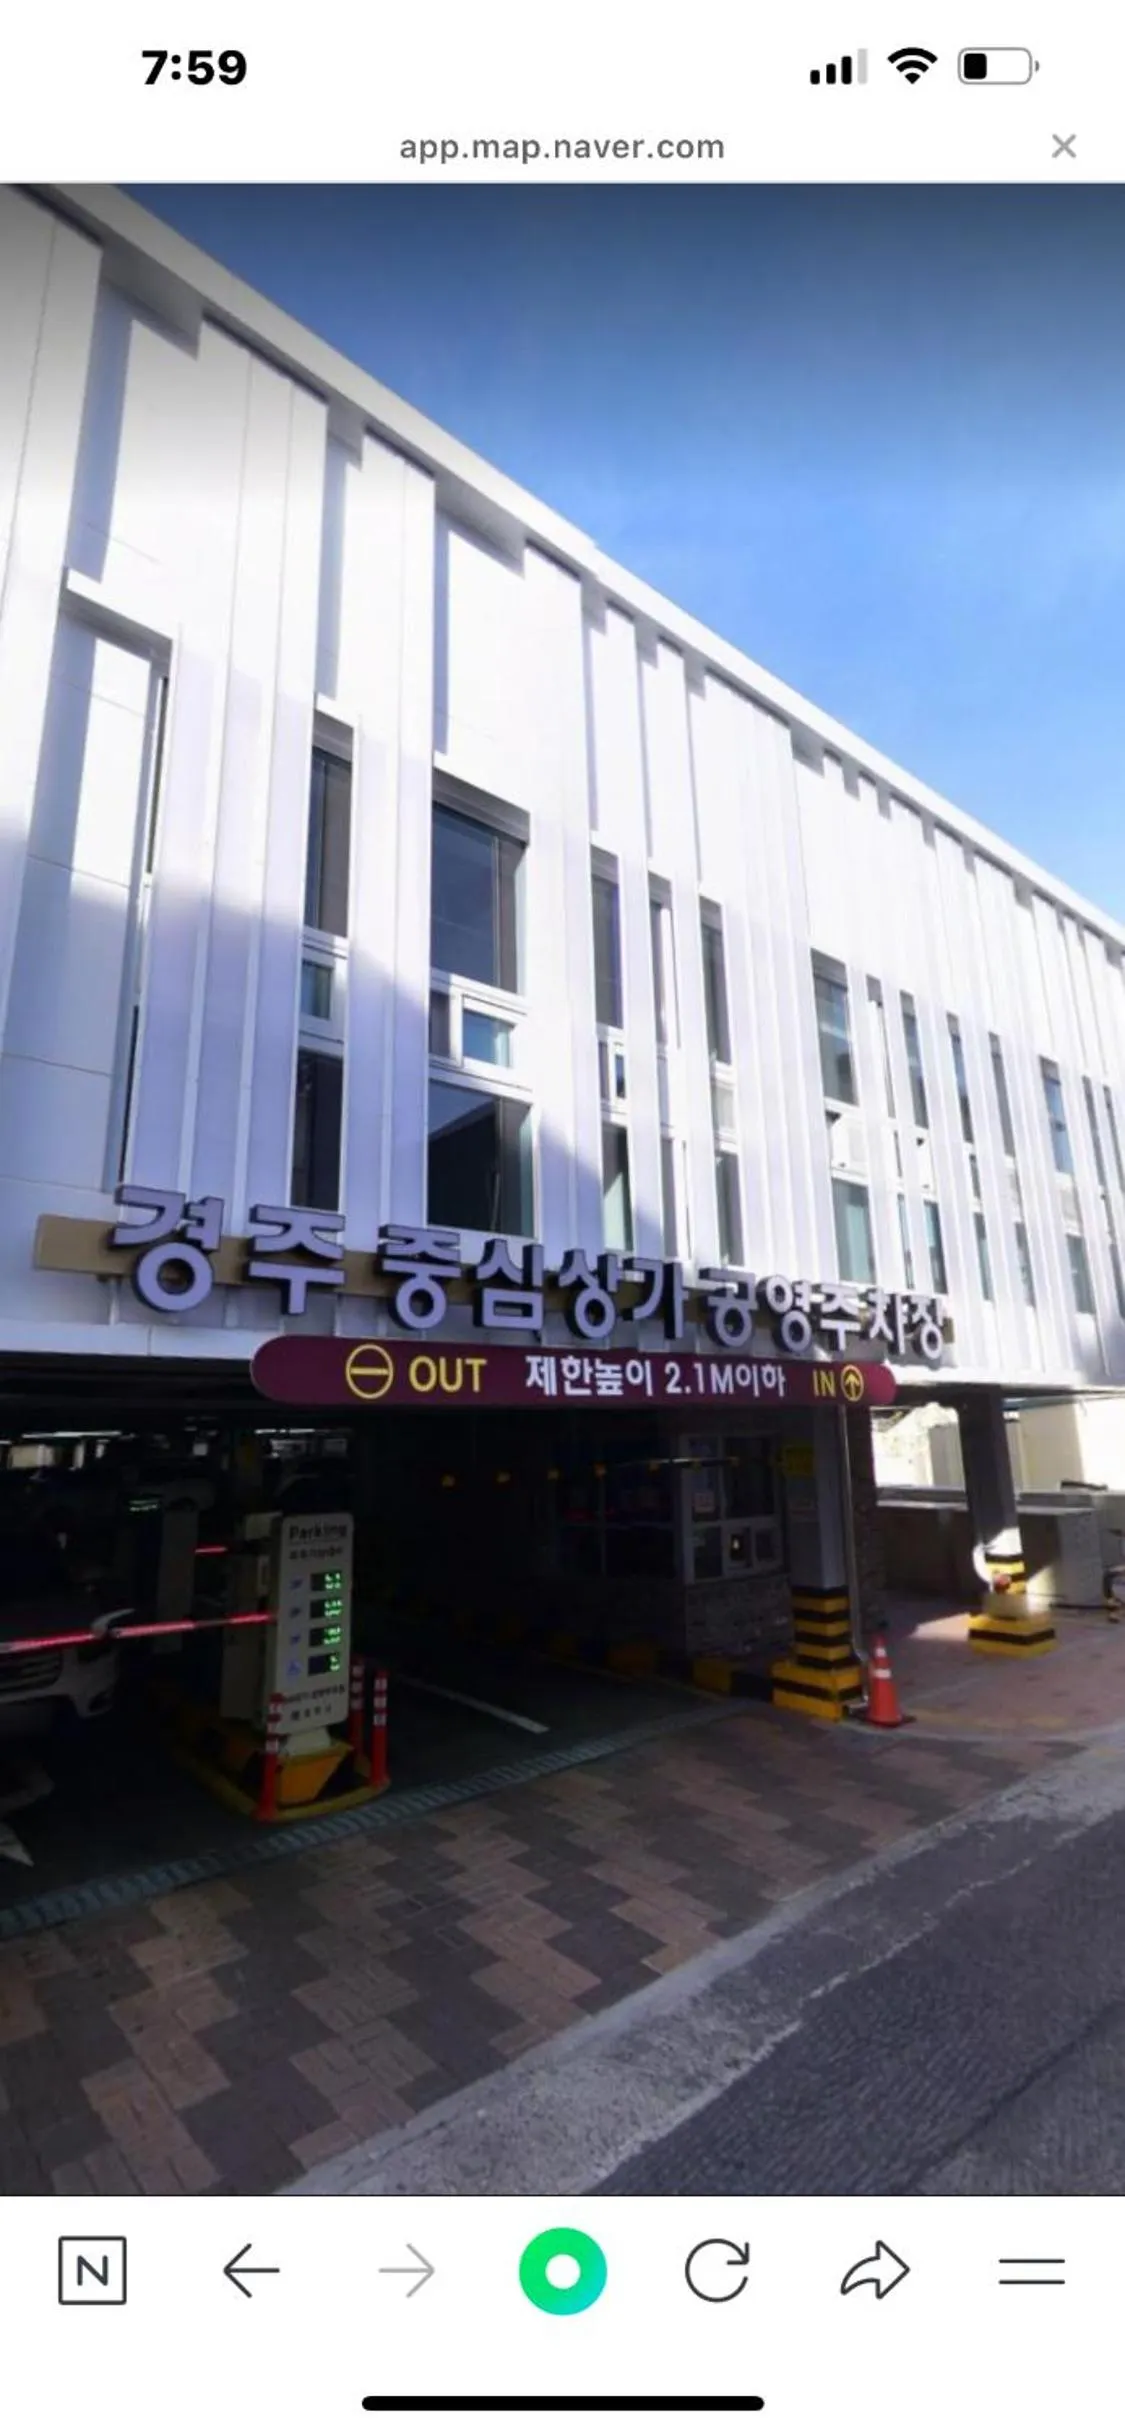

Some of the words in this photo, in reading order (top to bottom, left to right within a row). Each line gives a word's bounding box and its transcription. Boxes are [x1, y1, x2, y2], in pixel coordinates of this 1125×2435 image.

[109, 1185, 345, 1315] 경주
[378, 1224, 688, 1341] 중심상가
[700, 1266, 946, 1360] 공영주차장
[408, 1355, 487, 1393] OUT
[525, 1353, 654, 1397] 제한높이
[664, 1363, 787, 1398] 2.1M이하
[812, 1369, 836, 1397] IN
